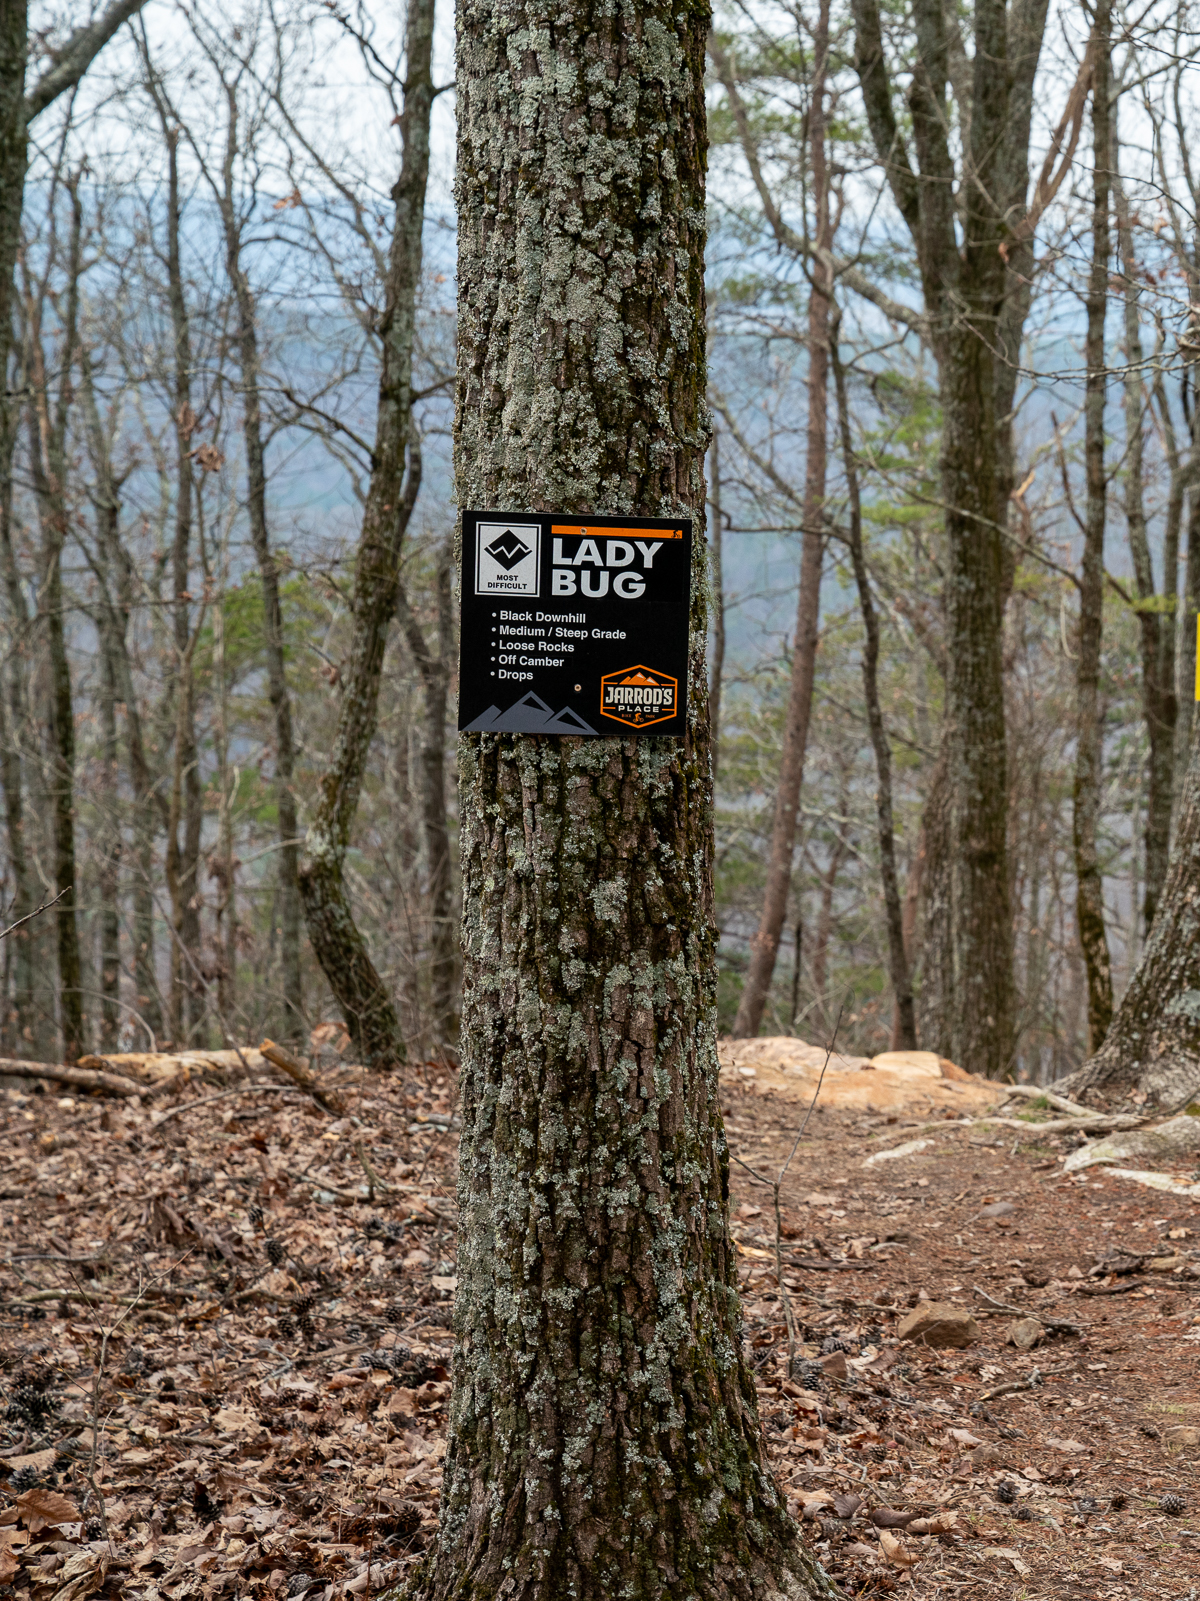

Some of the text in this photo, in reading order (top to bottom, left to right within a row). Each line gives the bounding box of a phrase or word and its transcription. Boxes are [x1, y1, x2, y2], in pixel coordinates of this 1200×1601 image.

[552, 538, 664, 568] LADY
[551, 569, 646, 599] BUG
[500, 610, 586, 624] Black Downhill
[500, 625, 626, 640] Medium / Steep Grade
[499, 640, 574, 652] Loose Rocks
[498, 655, 564, 667] Off Camber
[498, 669, 534, 681] Drops
[605, 687, 672, 705] JARROD'S
